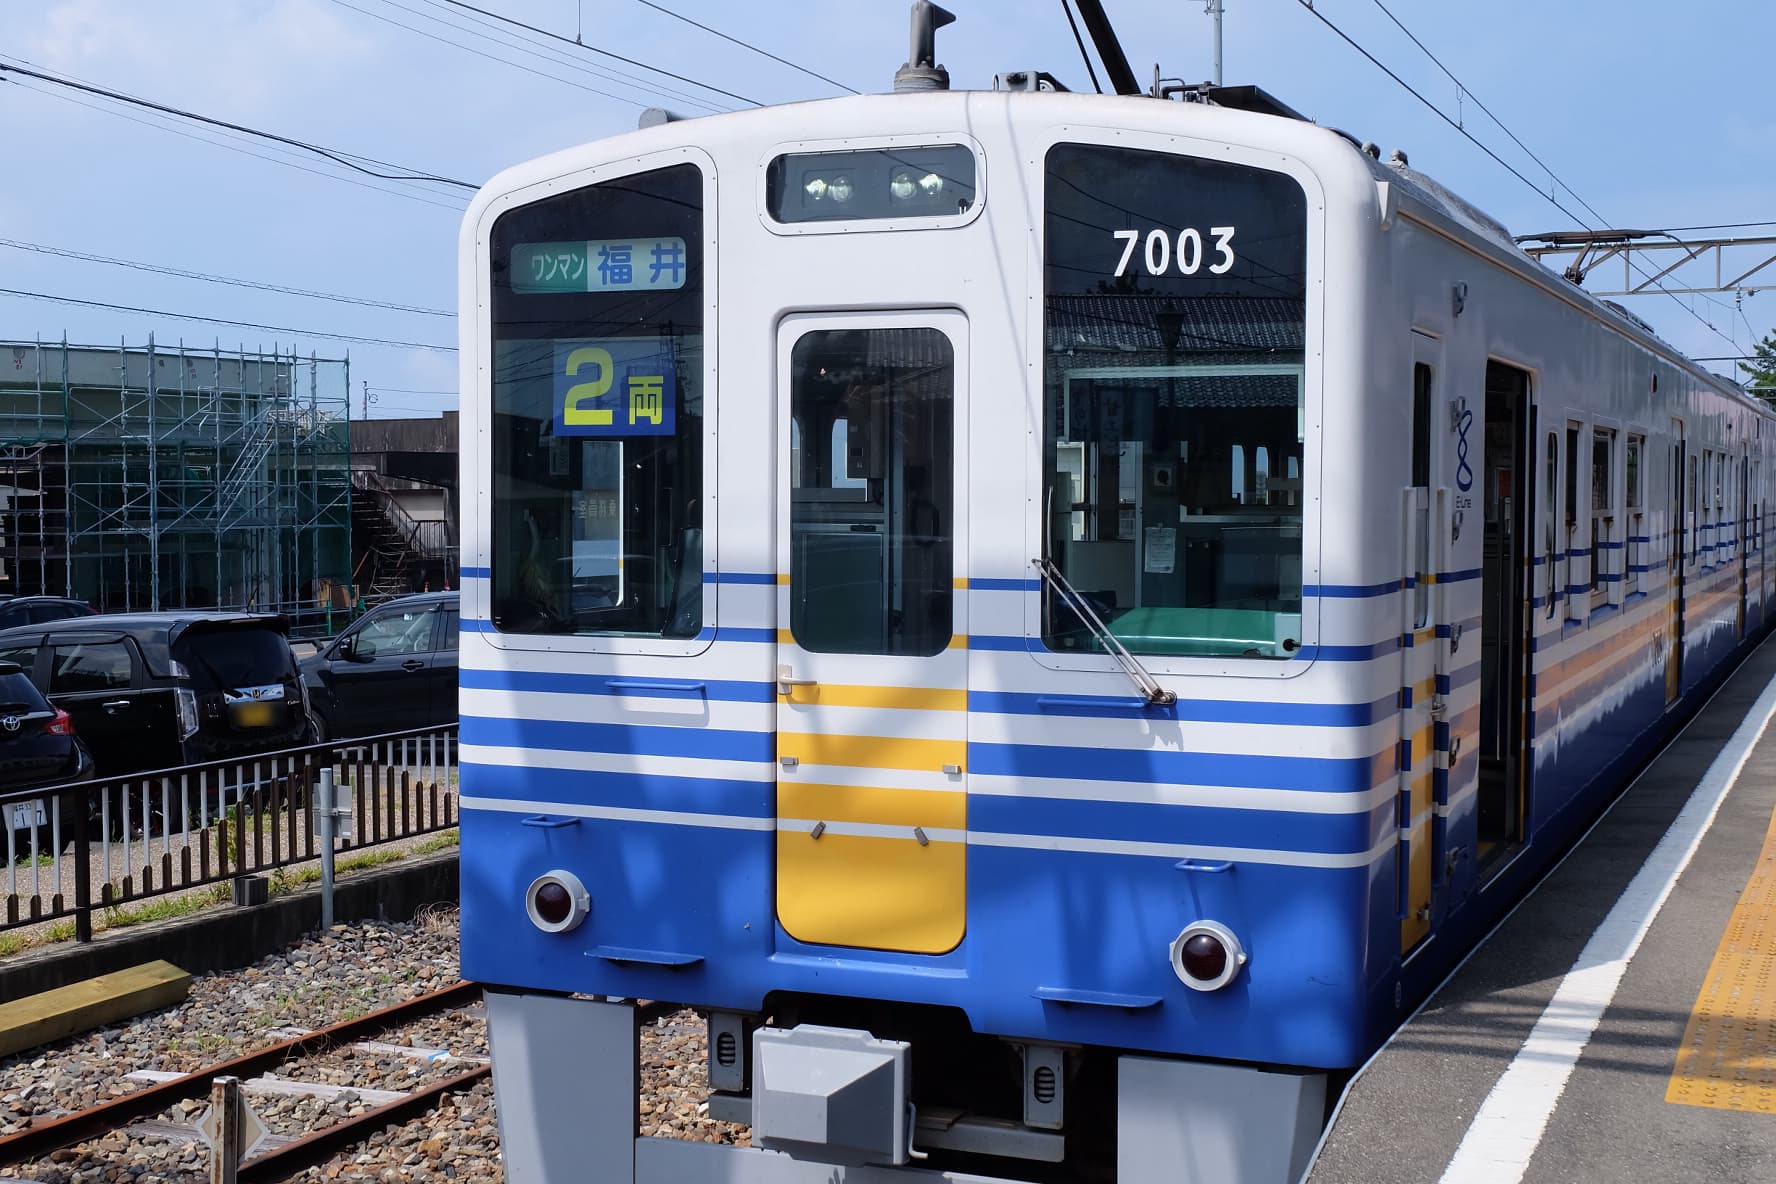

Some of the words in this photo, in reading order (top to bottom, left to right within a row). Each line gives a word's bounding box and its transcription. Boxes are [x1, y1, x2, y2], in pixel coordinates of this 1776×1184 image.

[532, 253, 584, 281] ワンマン
[597, 242, 685, 285] 福井
[1113, 226, 1235, 277] 7003
[564, 347, 664, 426] 2両
